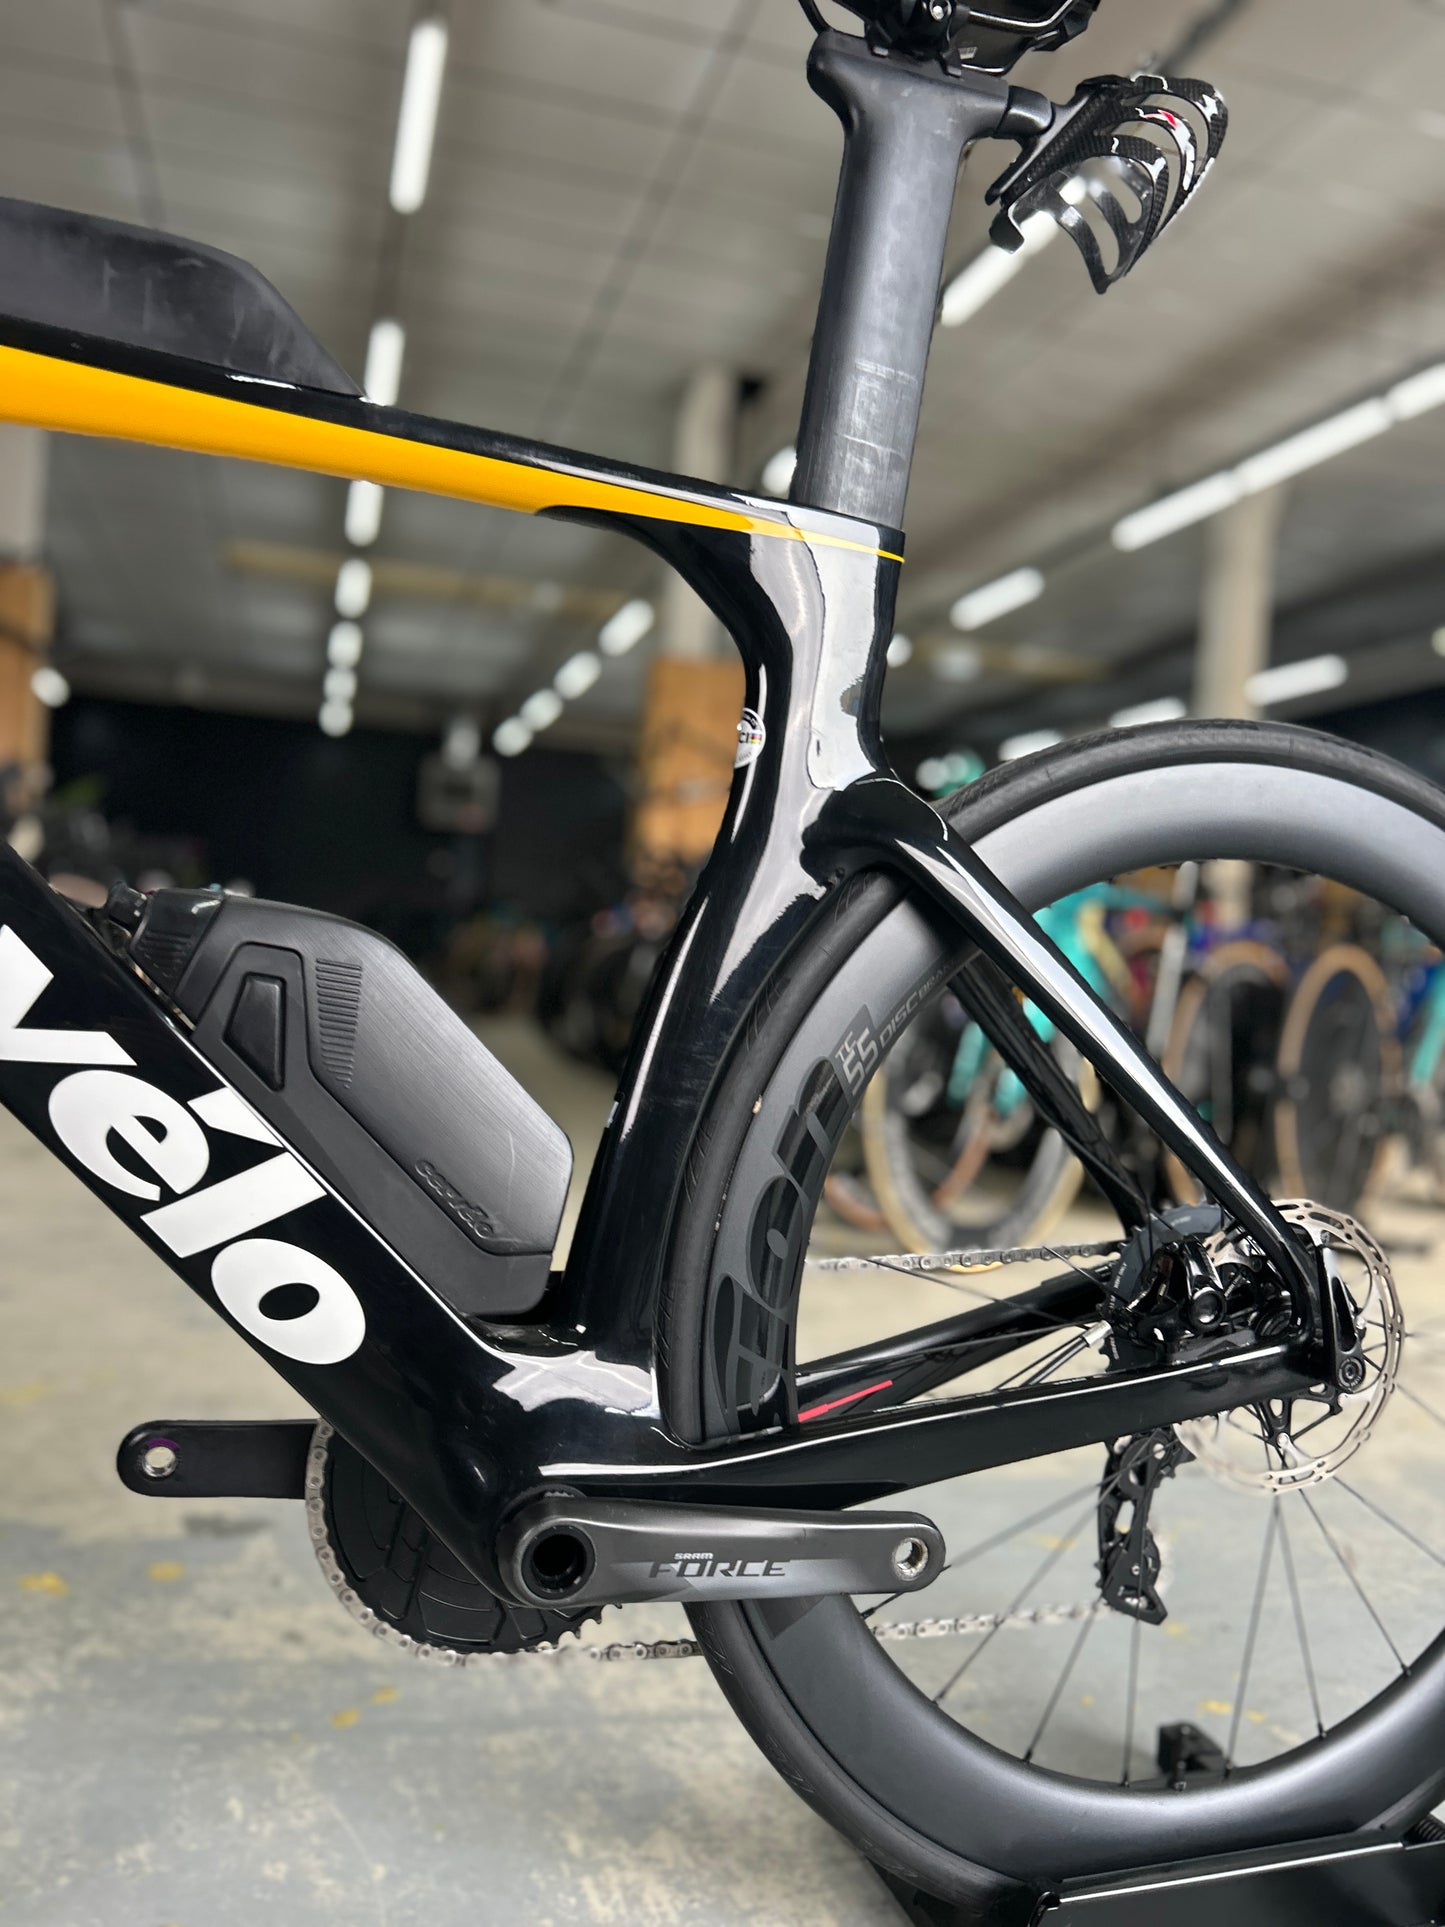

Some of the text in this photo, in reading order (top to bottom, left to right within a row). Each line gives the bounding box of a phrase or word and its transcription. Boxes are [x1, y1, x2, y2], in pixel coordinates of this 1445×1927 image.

[835, 1031, 857, 1062] TC
[842, 1027, 879, 1097] 55
[879, 991, 918, 1049] DISC
[649, 1560, 790, 1578] FORCE
